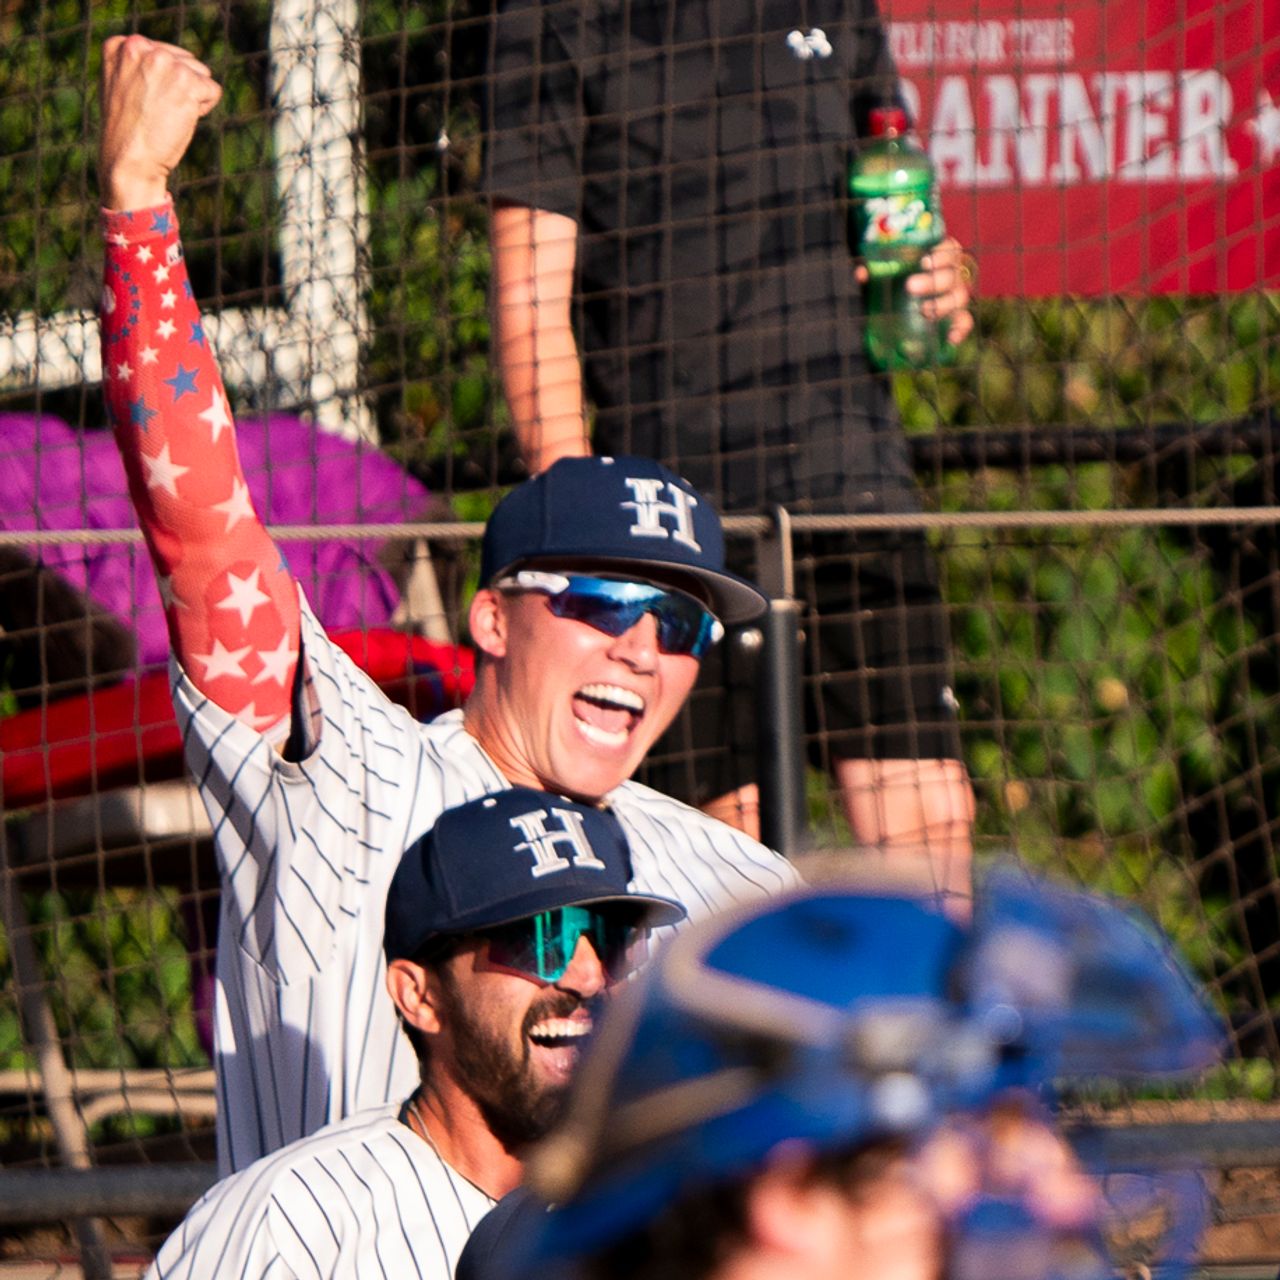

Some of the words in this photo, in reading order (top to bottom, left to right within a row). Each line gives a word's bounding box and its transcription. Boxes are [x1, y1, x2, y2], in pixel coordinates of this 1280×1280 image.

[943, 20, 1006, 62] FOR
[1007, 18, 1075, 61] THE
[620, 477, 701, 552] H
[510, 807, 605, 878] H
